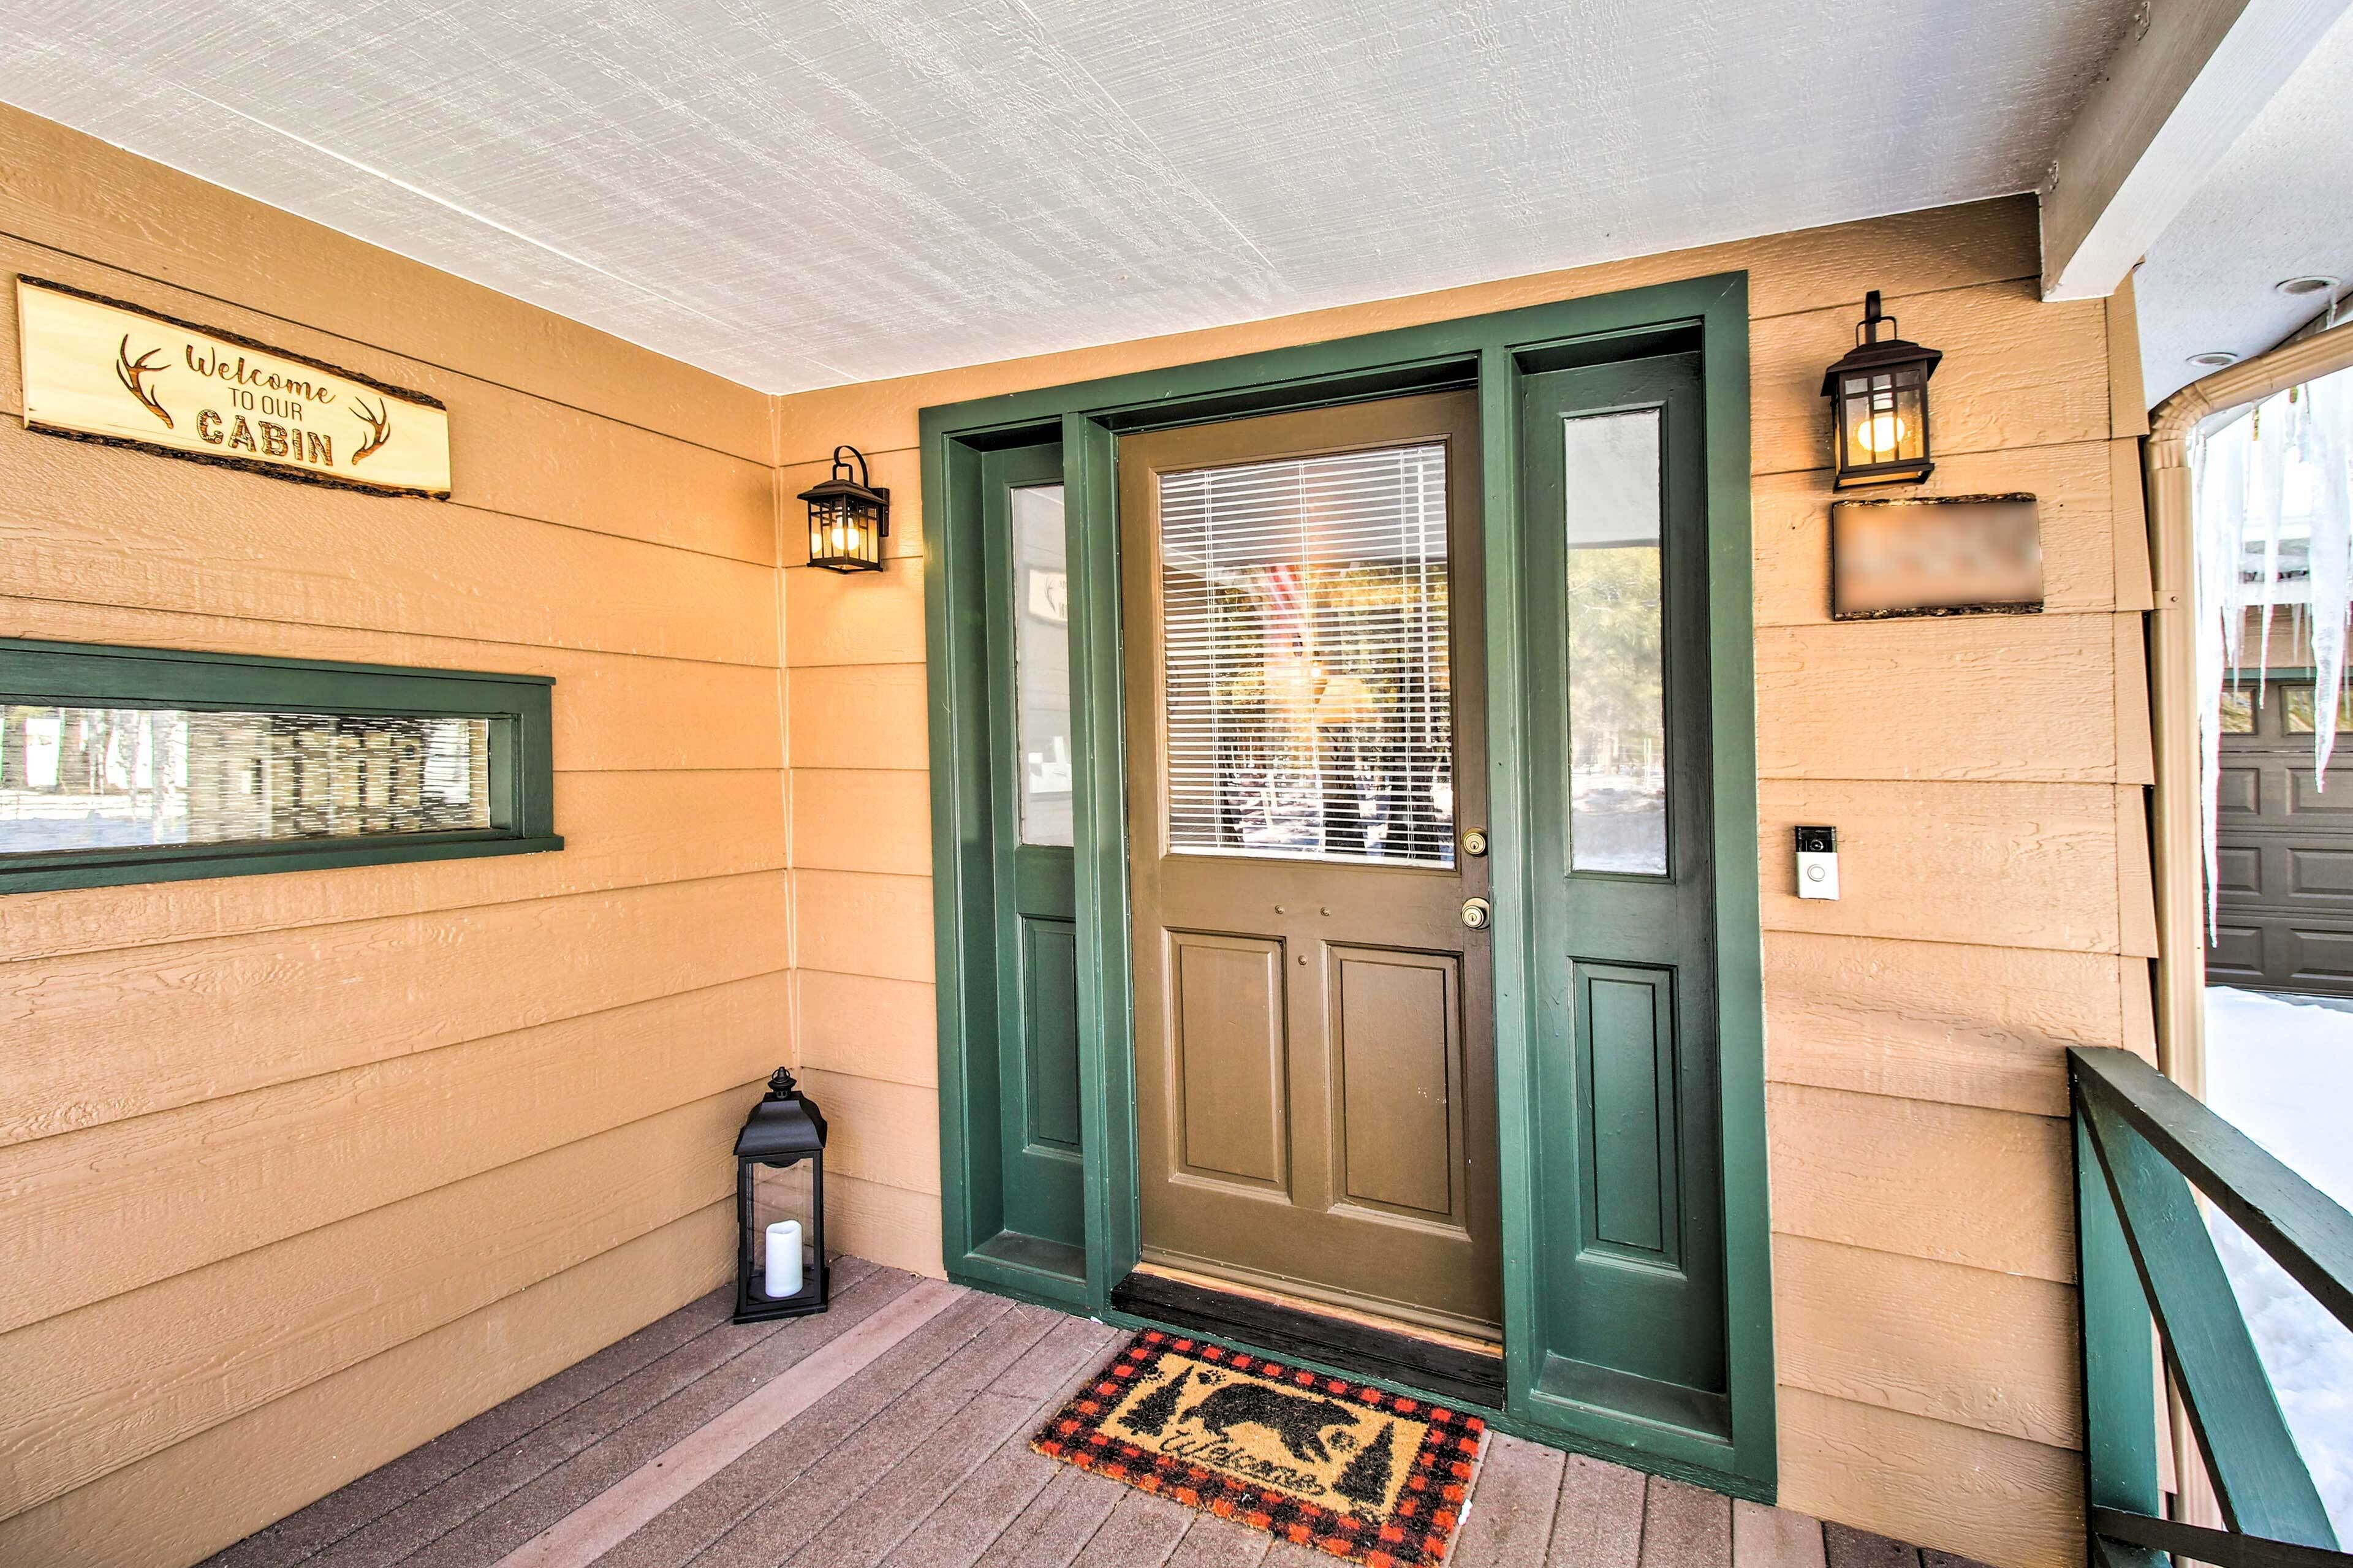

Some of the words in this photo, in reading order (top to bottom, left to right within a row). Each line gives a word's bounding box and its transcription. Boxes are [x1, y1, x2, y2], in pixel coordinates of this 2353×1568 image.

[186, 344, 336, 404] Welcome
[227, 387, 254, 411] TO
[262, 395, 303, 422] OUR
[196, 409, 333, 466] CABIN
[1159, 1429, 1327, 1496] Welcome
